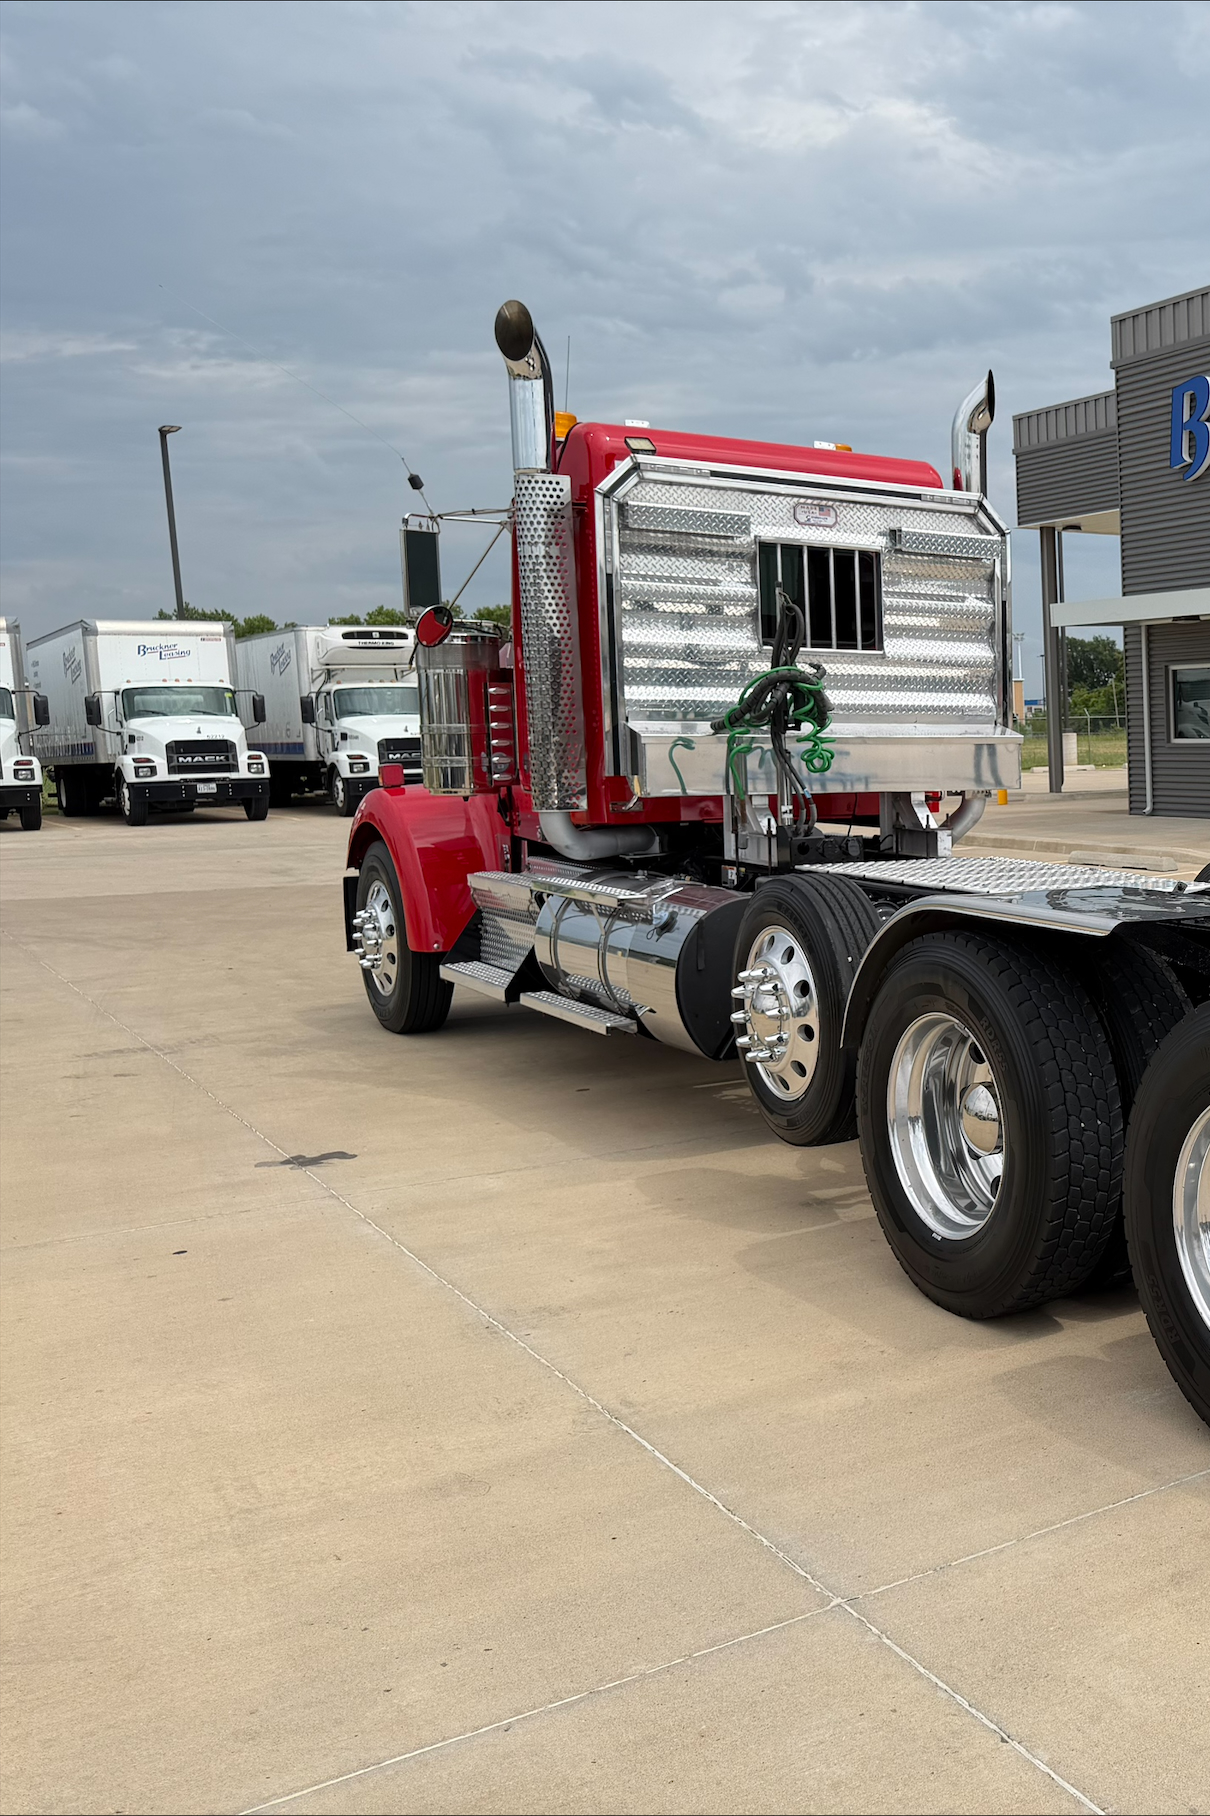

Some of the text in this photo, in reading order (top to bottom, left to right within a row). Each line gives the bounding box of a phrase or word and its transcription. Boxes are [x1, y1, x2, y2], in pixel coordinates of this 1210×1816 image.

[137, 643, 178, 657] Bruckner
[159, 649, 191, 660] Leasing
[178, 755, 227, 763] MACK
[388, 752, 421, 760] MAC
[980, 1016, 1008, 1072] RDR55
